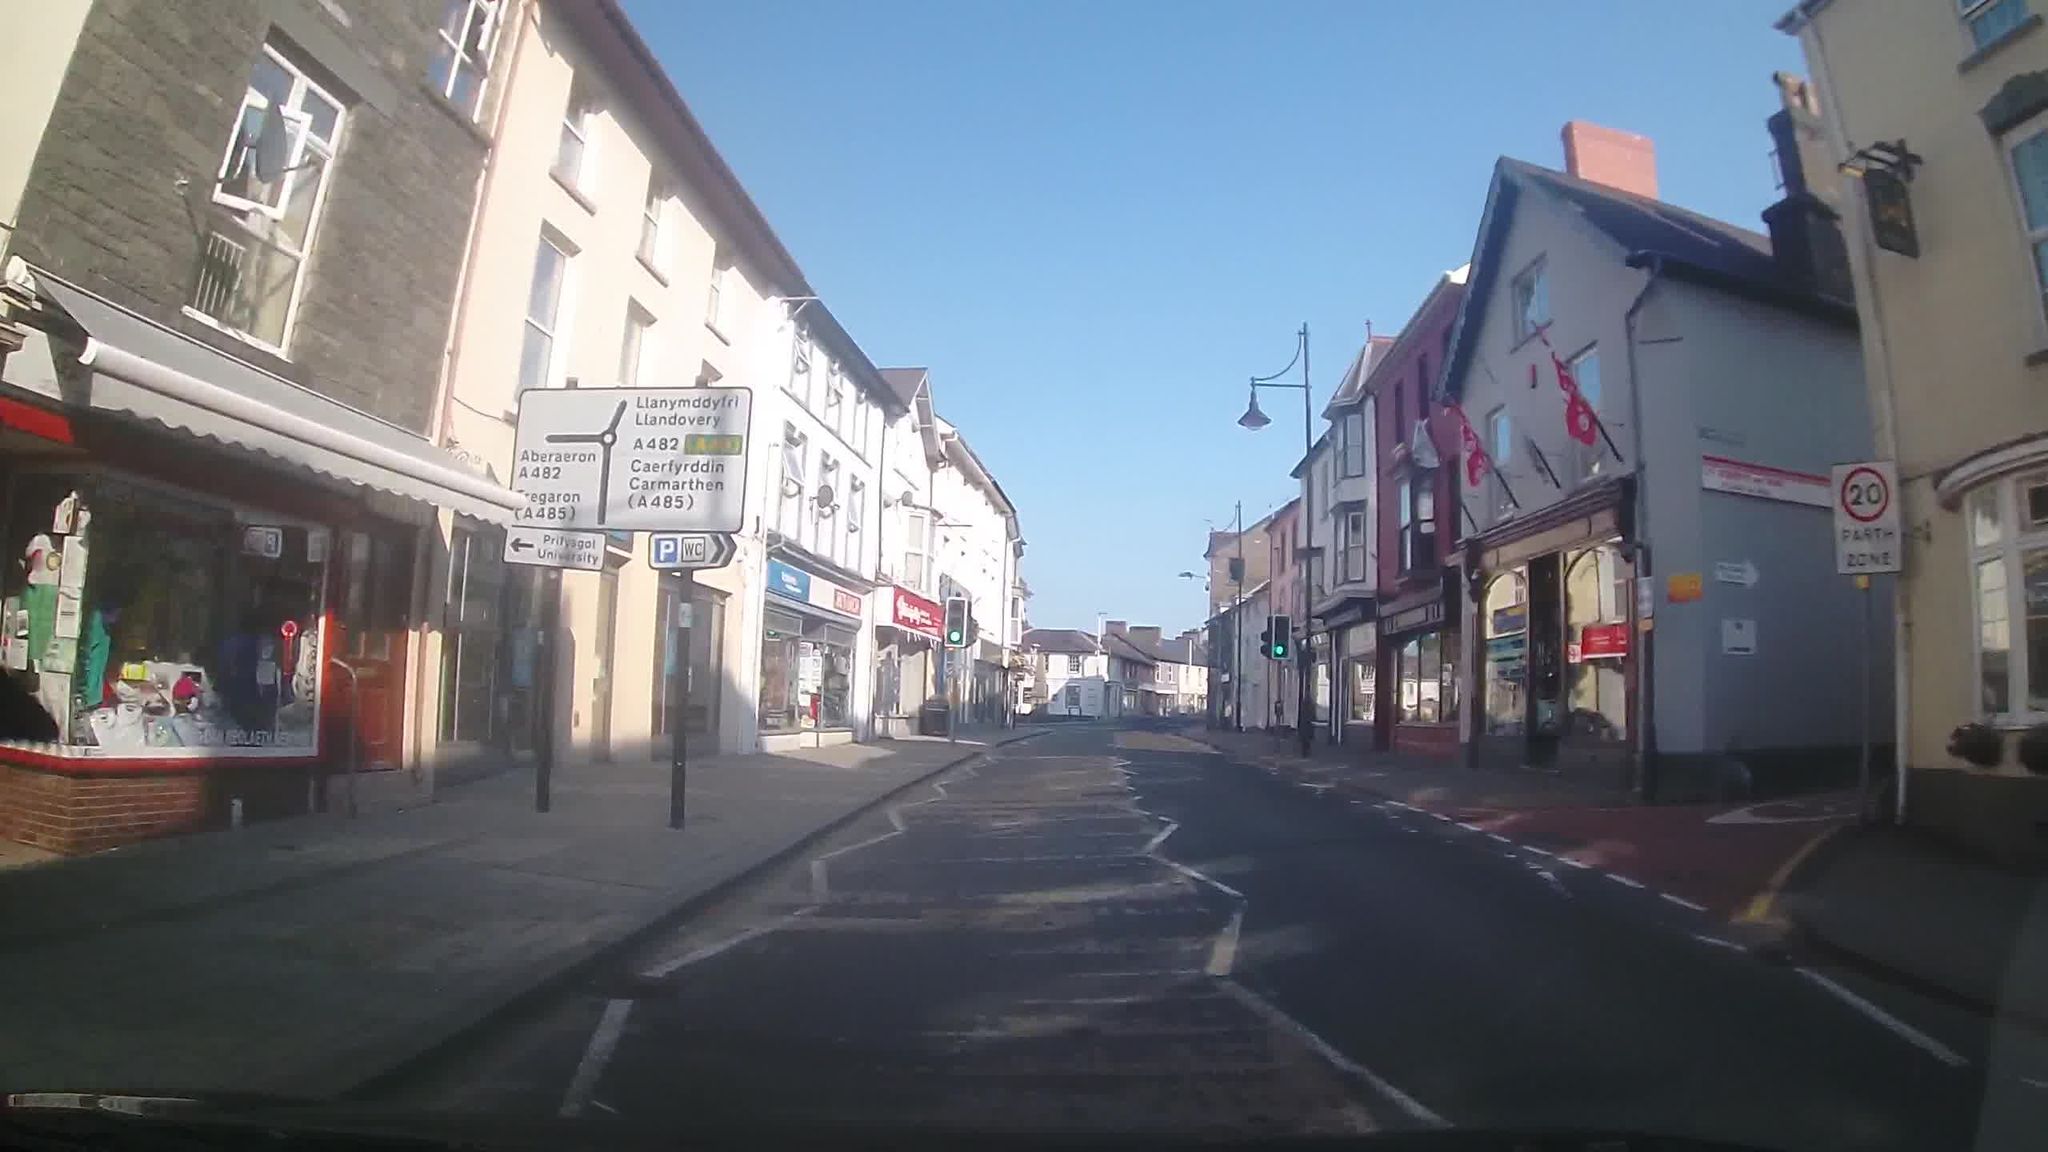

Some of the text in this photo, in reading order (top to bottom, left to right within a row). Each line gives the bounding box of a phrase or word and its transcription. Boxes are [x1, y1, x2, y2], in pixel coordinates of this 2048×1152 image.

[636, 395, 739, 410] Llanymddyfri
[635, 412, 720, 429] Llandovery
[521, 449, 596, 463] Aberaeron
[631, 459, 725, 476] Caerfyrddin
[629, 477, 725, 491] Carmarthen
[1849, 483, 1881, 505] 20
[538, 549, 599, 565] Unirsity
[659, 540, 703, 562] P WC
[1847, 552, 1892, 567] ZONE
